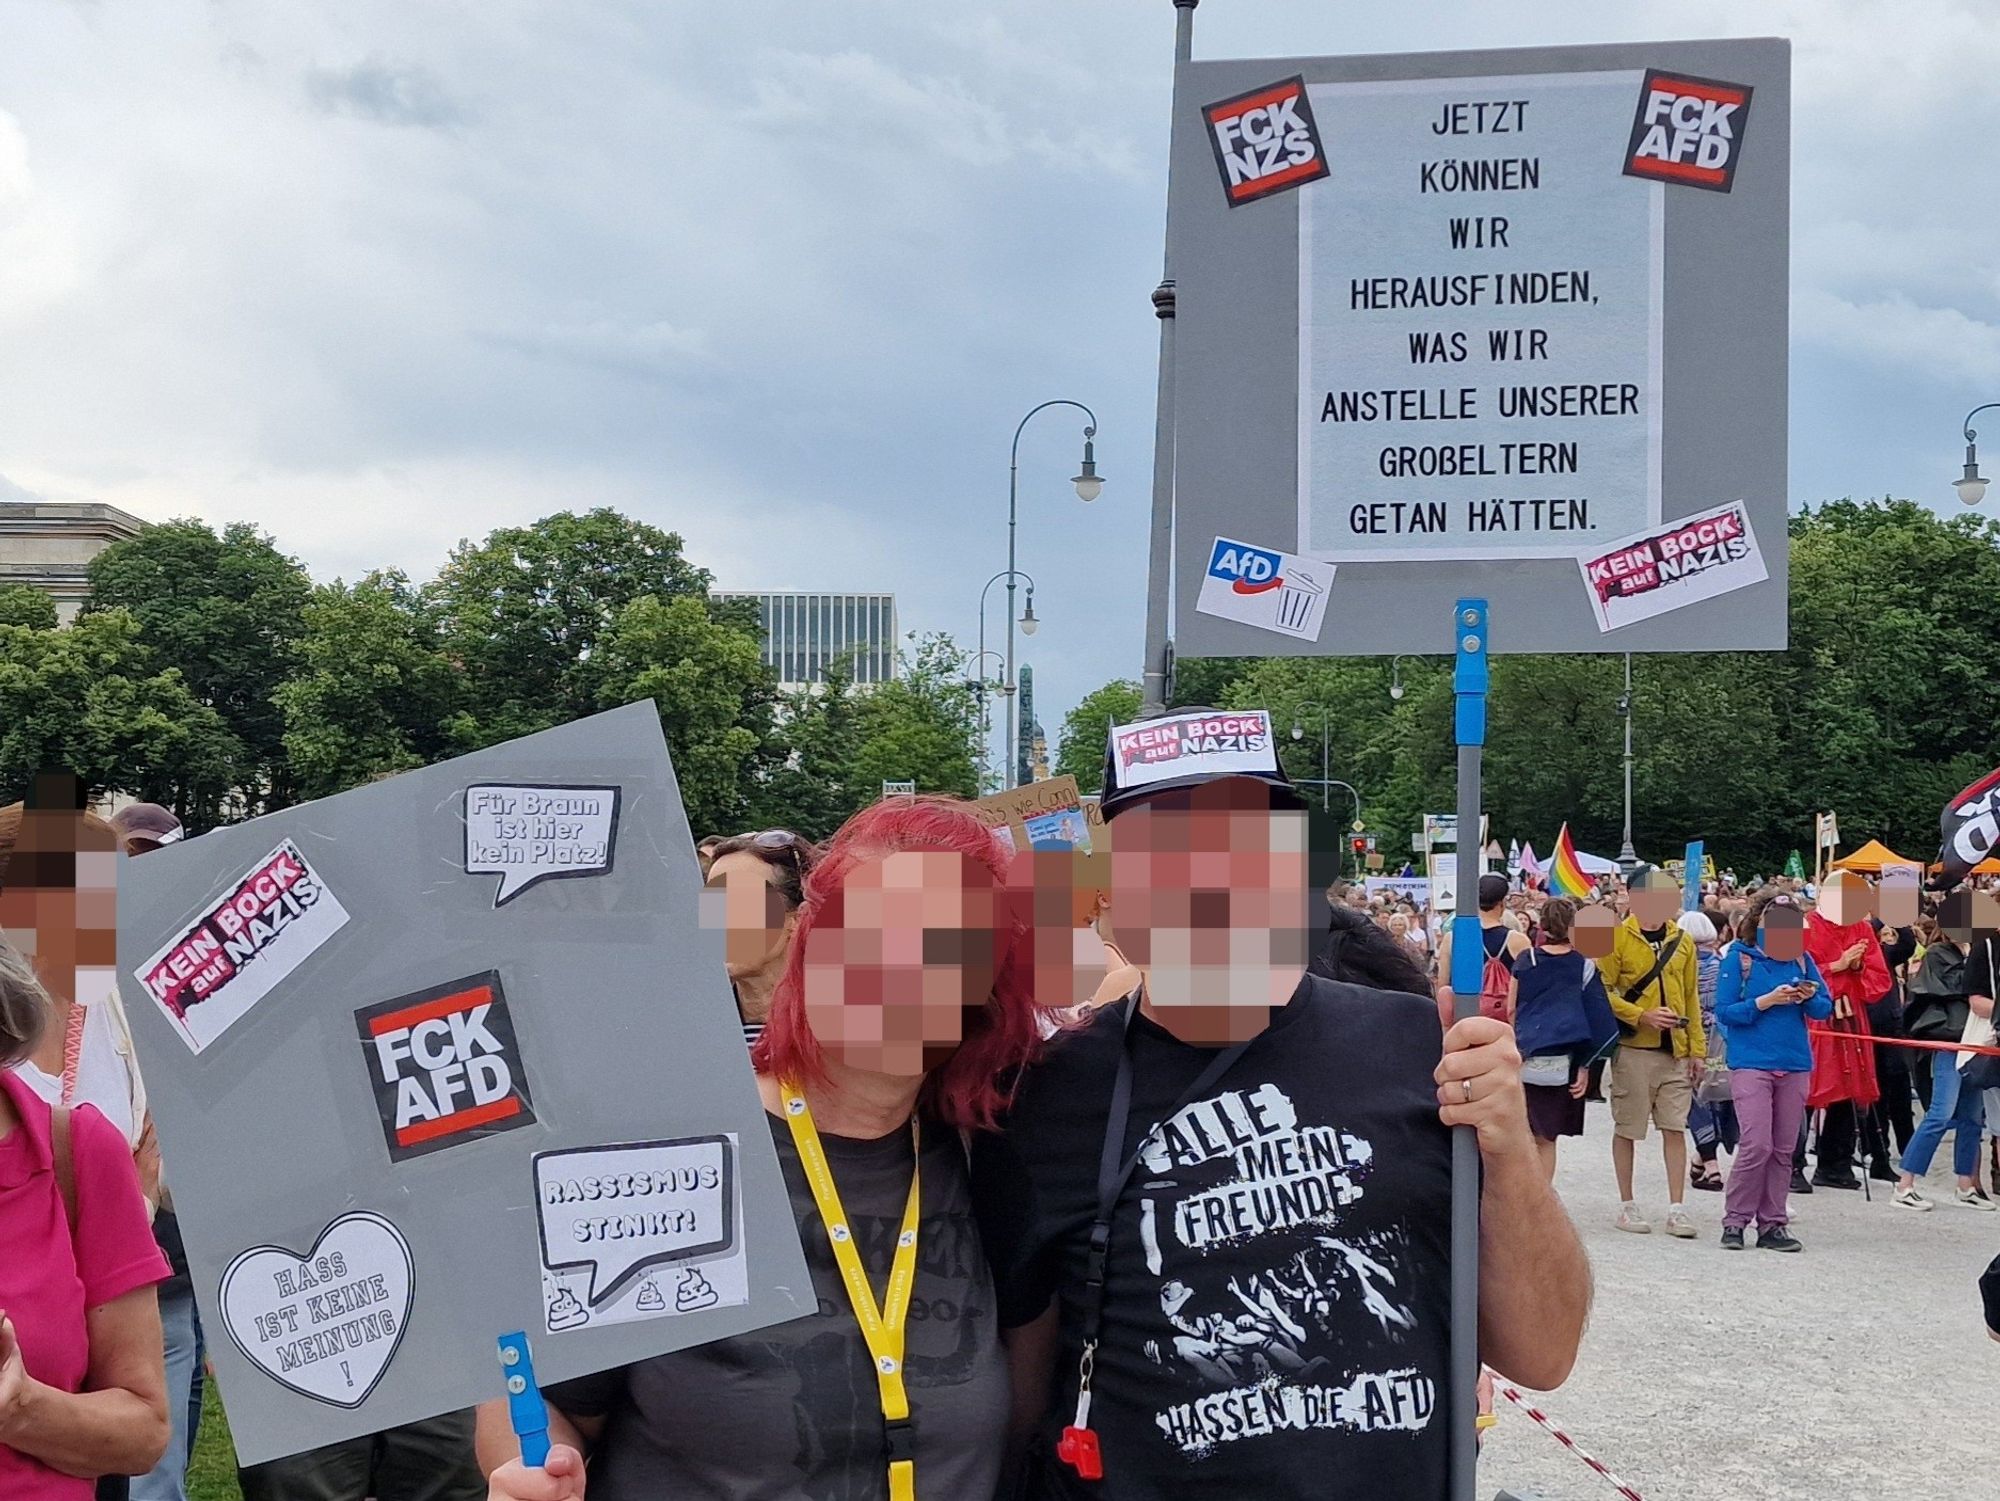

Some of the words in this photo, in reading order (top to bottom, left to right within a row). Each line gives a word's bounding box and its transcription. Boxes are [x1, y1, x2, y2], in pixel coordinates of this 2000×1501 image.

[1214, 95, 1308, 154] FCK
[1432, 101, 1530, 135] JETZT
[1643, 89, 1740, 139] FCK
[1223, 129, 1315, 186] NZS
[1635, 124, 1730, 170] AFD
[1421, 157, 1539, 193] KÖNNEN
[1450, 216, 1509, 249] WIR
[1351, 270, 1599, 309] HERAUSFINDEN,
[1409, 331, 1468, 363] WAS
[1489, 329, 1548, 361] WIR
[1321, 388, 1477, 422] ANSTELLE
[1500, 384, 1639, 417] UNSERER
[1380, 442, 1577, 477] GROßELTERN
[1350, 502, 1447, 534] GETAN
[1469, 498, 1597, 531] HÄTTEN.
[1215, 548, 1272, 581] AfD
[1590, 544, 1655, 583] KEIN
[1658, 516, 1737, 559] BOCK
[1621, 568, 1656, 590] auf
[1657, 538, 1750, 581] NAZIS
[1121, 726, 1179, 751] KEIN
[1187, 718, 1257, 738] BOCK
[1145, 743, 1177, 759] auf
[1181, 735, 1266, 754] NAZIS
[472, 792, 516, 815] Für
[523, 792, 600, 815] Braun
[495, 816, 527, 839] ist
[533, 817, 583, 839] hier
[472, 840, 524, 863] kein
[530, 841, 607, 864] Platz!
[151, 928, 220, 999] KEIN
[217, 858, 298, 937] BOCK
[191, 955, 230, 993] auf
[223, 877, 320, 965] NAZIS
[375, 1003, 504, 1083] FCK
[395, 1054, 511, 1129] AFD
[1160, 1090, 1281, 1167] ALLE
[1243, 1130, 1354, 1183] MEINE
[545, 1165, 719, 1204] RASSISMUS
[573, 1208, 696, 1243] STINKT!
[1182, 1170, 1354, 1246] FREUNDE
[273, 1251, 348, 1298] HASS
[254, 1304, 299, 1342] IST
[306, 1273, 389, 1324] KEINE
[276, 1309, 397, 1372] MEINUNG
[340, 1361, 354, 1387] !
[1168, 1388, 1289, 1444] HASSEN
[1305, 1391, 1345, 1426] DIE
[1363, 1376, 1432, 1429] AFD
